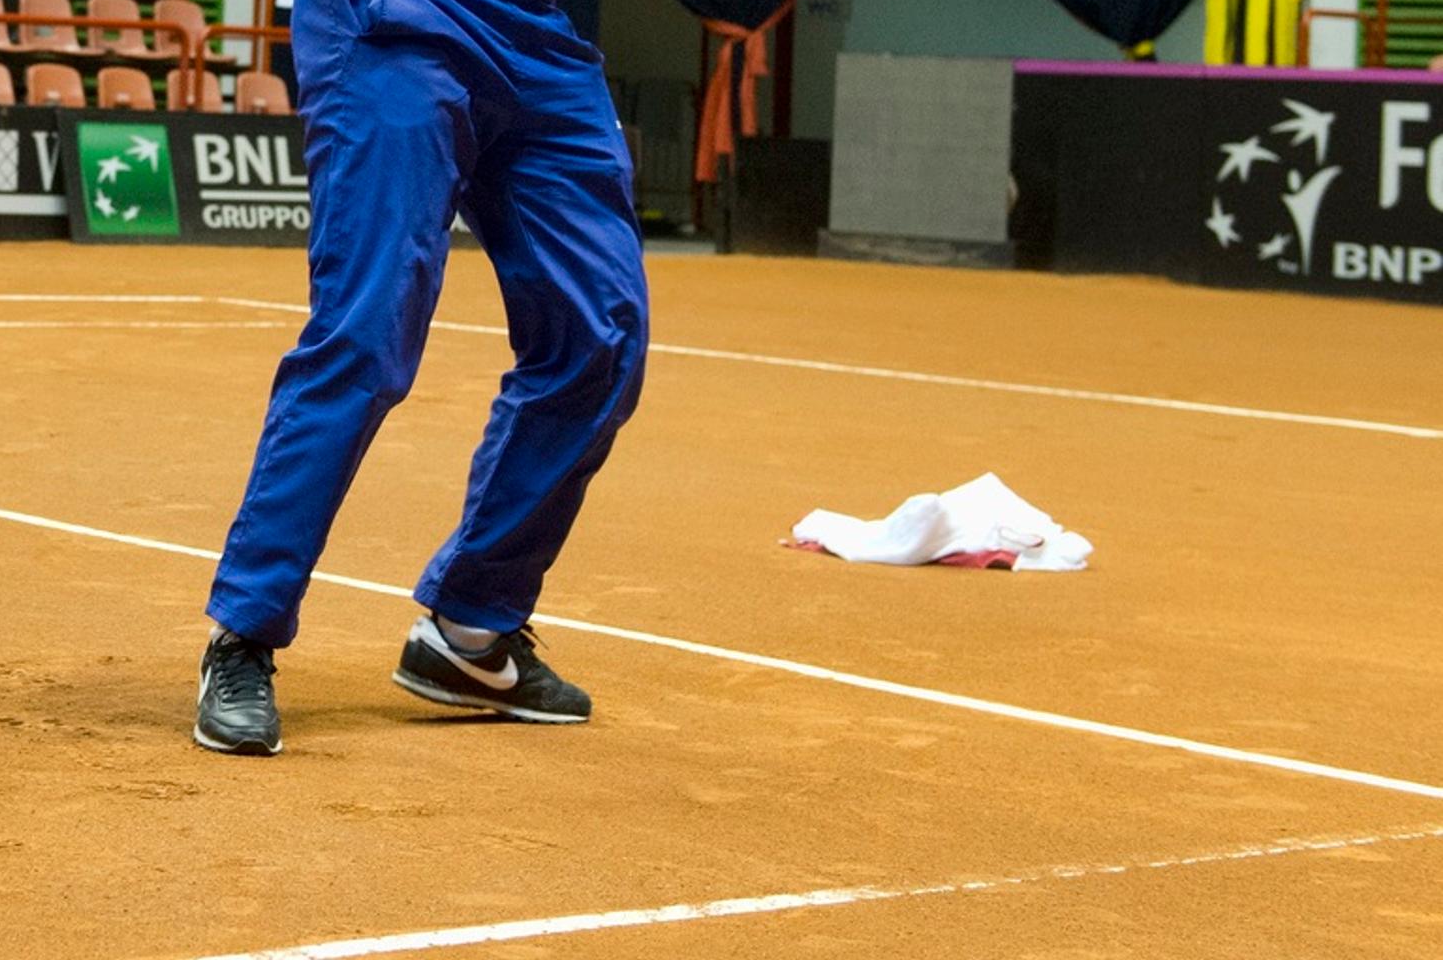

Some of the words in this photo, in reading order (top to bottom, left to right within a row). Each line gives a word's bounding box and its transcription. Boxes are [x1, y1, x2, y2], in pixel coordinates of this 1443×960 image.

[194, 133, 309, 186] BNL
[202, 203, 312, 231] GRUPPO
[1332, 242, 1443, 284] BNP
